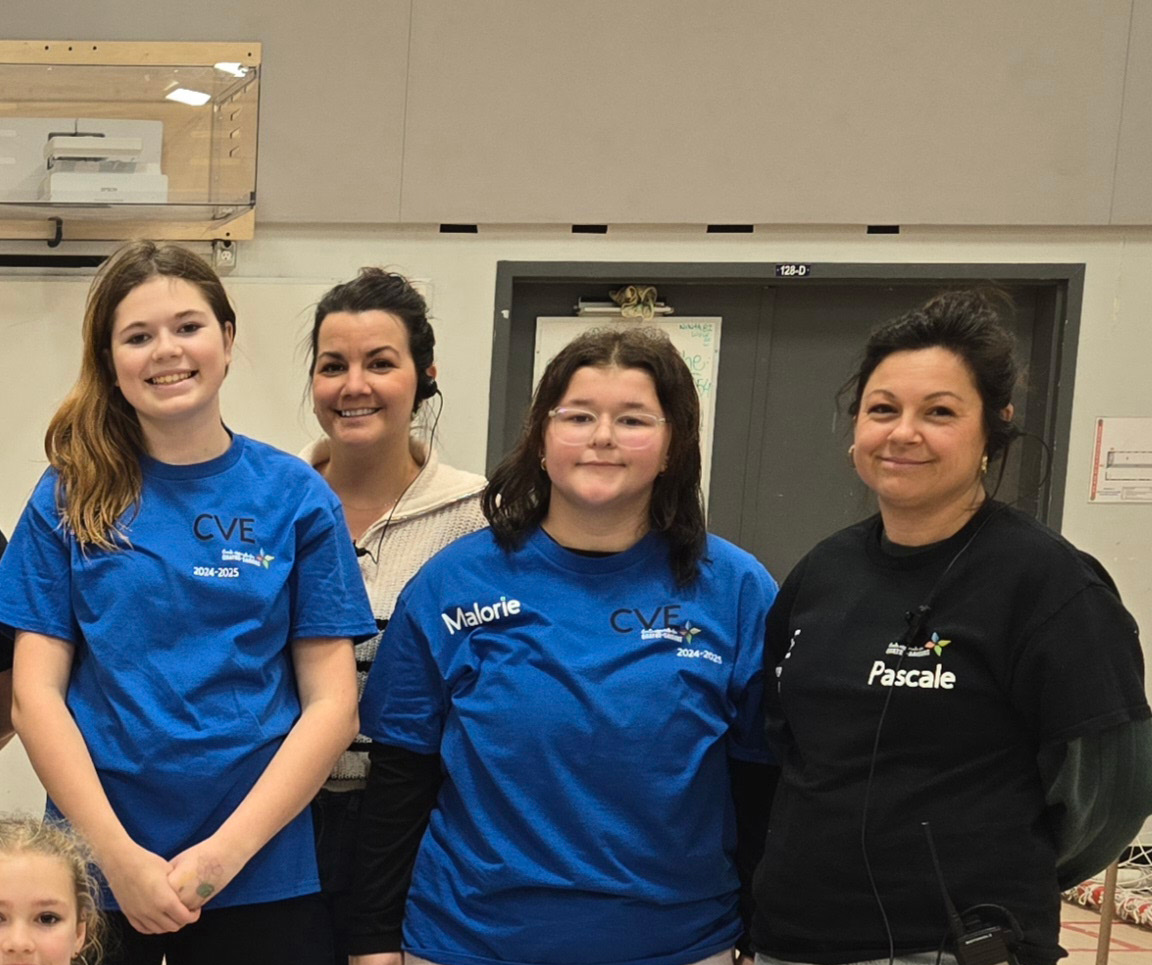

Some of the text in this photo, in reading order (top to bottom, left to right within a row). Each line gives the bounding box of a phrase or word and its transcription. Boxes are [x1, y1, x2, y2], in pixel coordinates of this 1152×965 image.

[780, 264, 806, 276] 128-D
[192, 513, 256, 545] CVE
[193, 566, 240, 578] 2024-2025
[441, 596, 521, 635] Malorie
[609, 605, 682, 633] CVE
[676, 647, 722, 664] 2024-2025
[867, 660, 957, 689] Pascale
